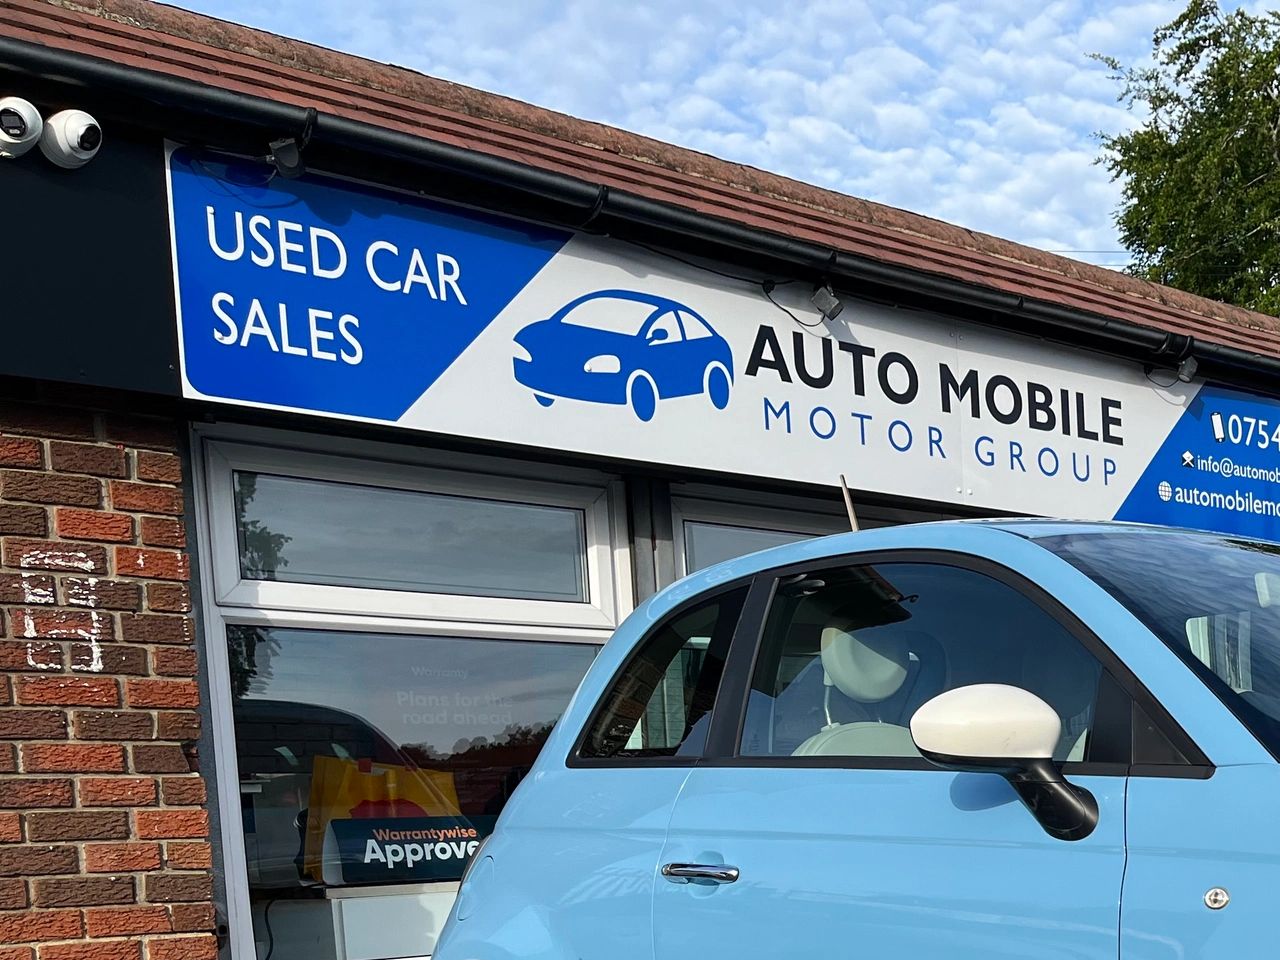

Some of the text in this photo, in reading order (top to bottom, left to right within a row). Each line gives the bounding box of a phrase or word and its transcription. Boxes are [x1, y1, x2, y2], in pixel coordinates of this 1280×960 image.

[206, 205, 468, 306] USED CAR
[211, 291, 364, 366] SALES
[744, 324, 1124, 446] AUTO MOBILE
[763, 397, 1117, 486] MOTOR GROUP
[372, 826, 477, 841] Warrantywise
